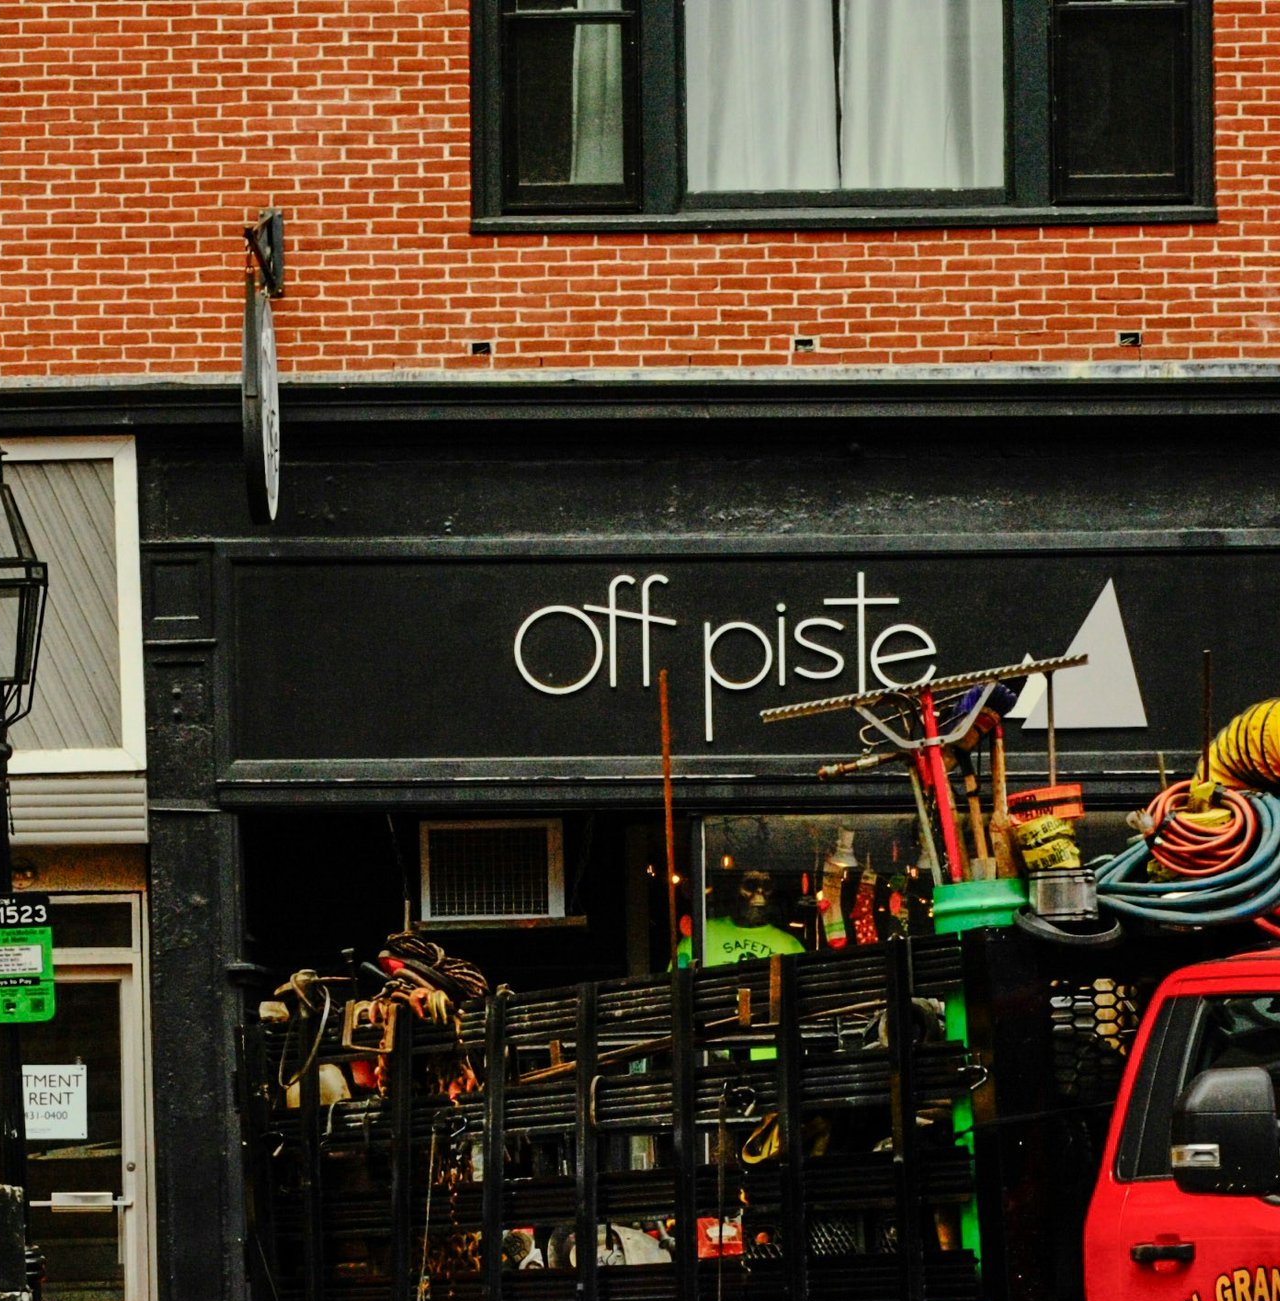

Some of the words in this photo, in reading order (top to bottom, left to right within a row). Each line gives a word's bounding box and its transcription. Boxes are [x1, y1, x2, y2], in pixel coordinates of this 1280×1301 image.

[514, 574, 677, 694] off
[704, 572, 937, 742] piste
[29, 1092, 74, 1105] RENT
